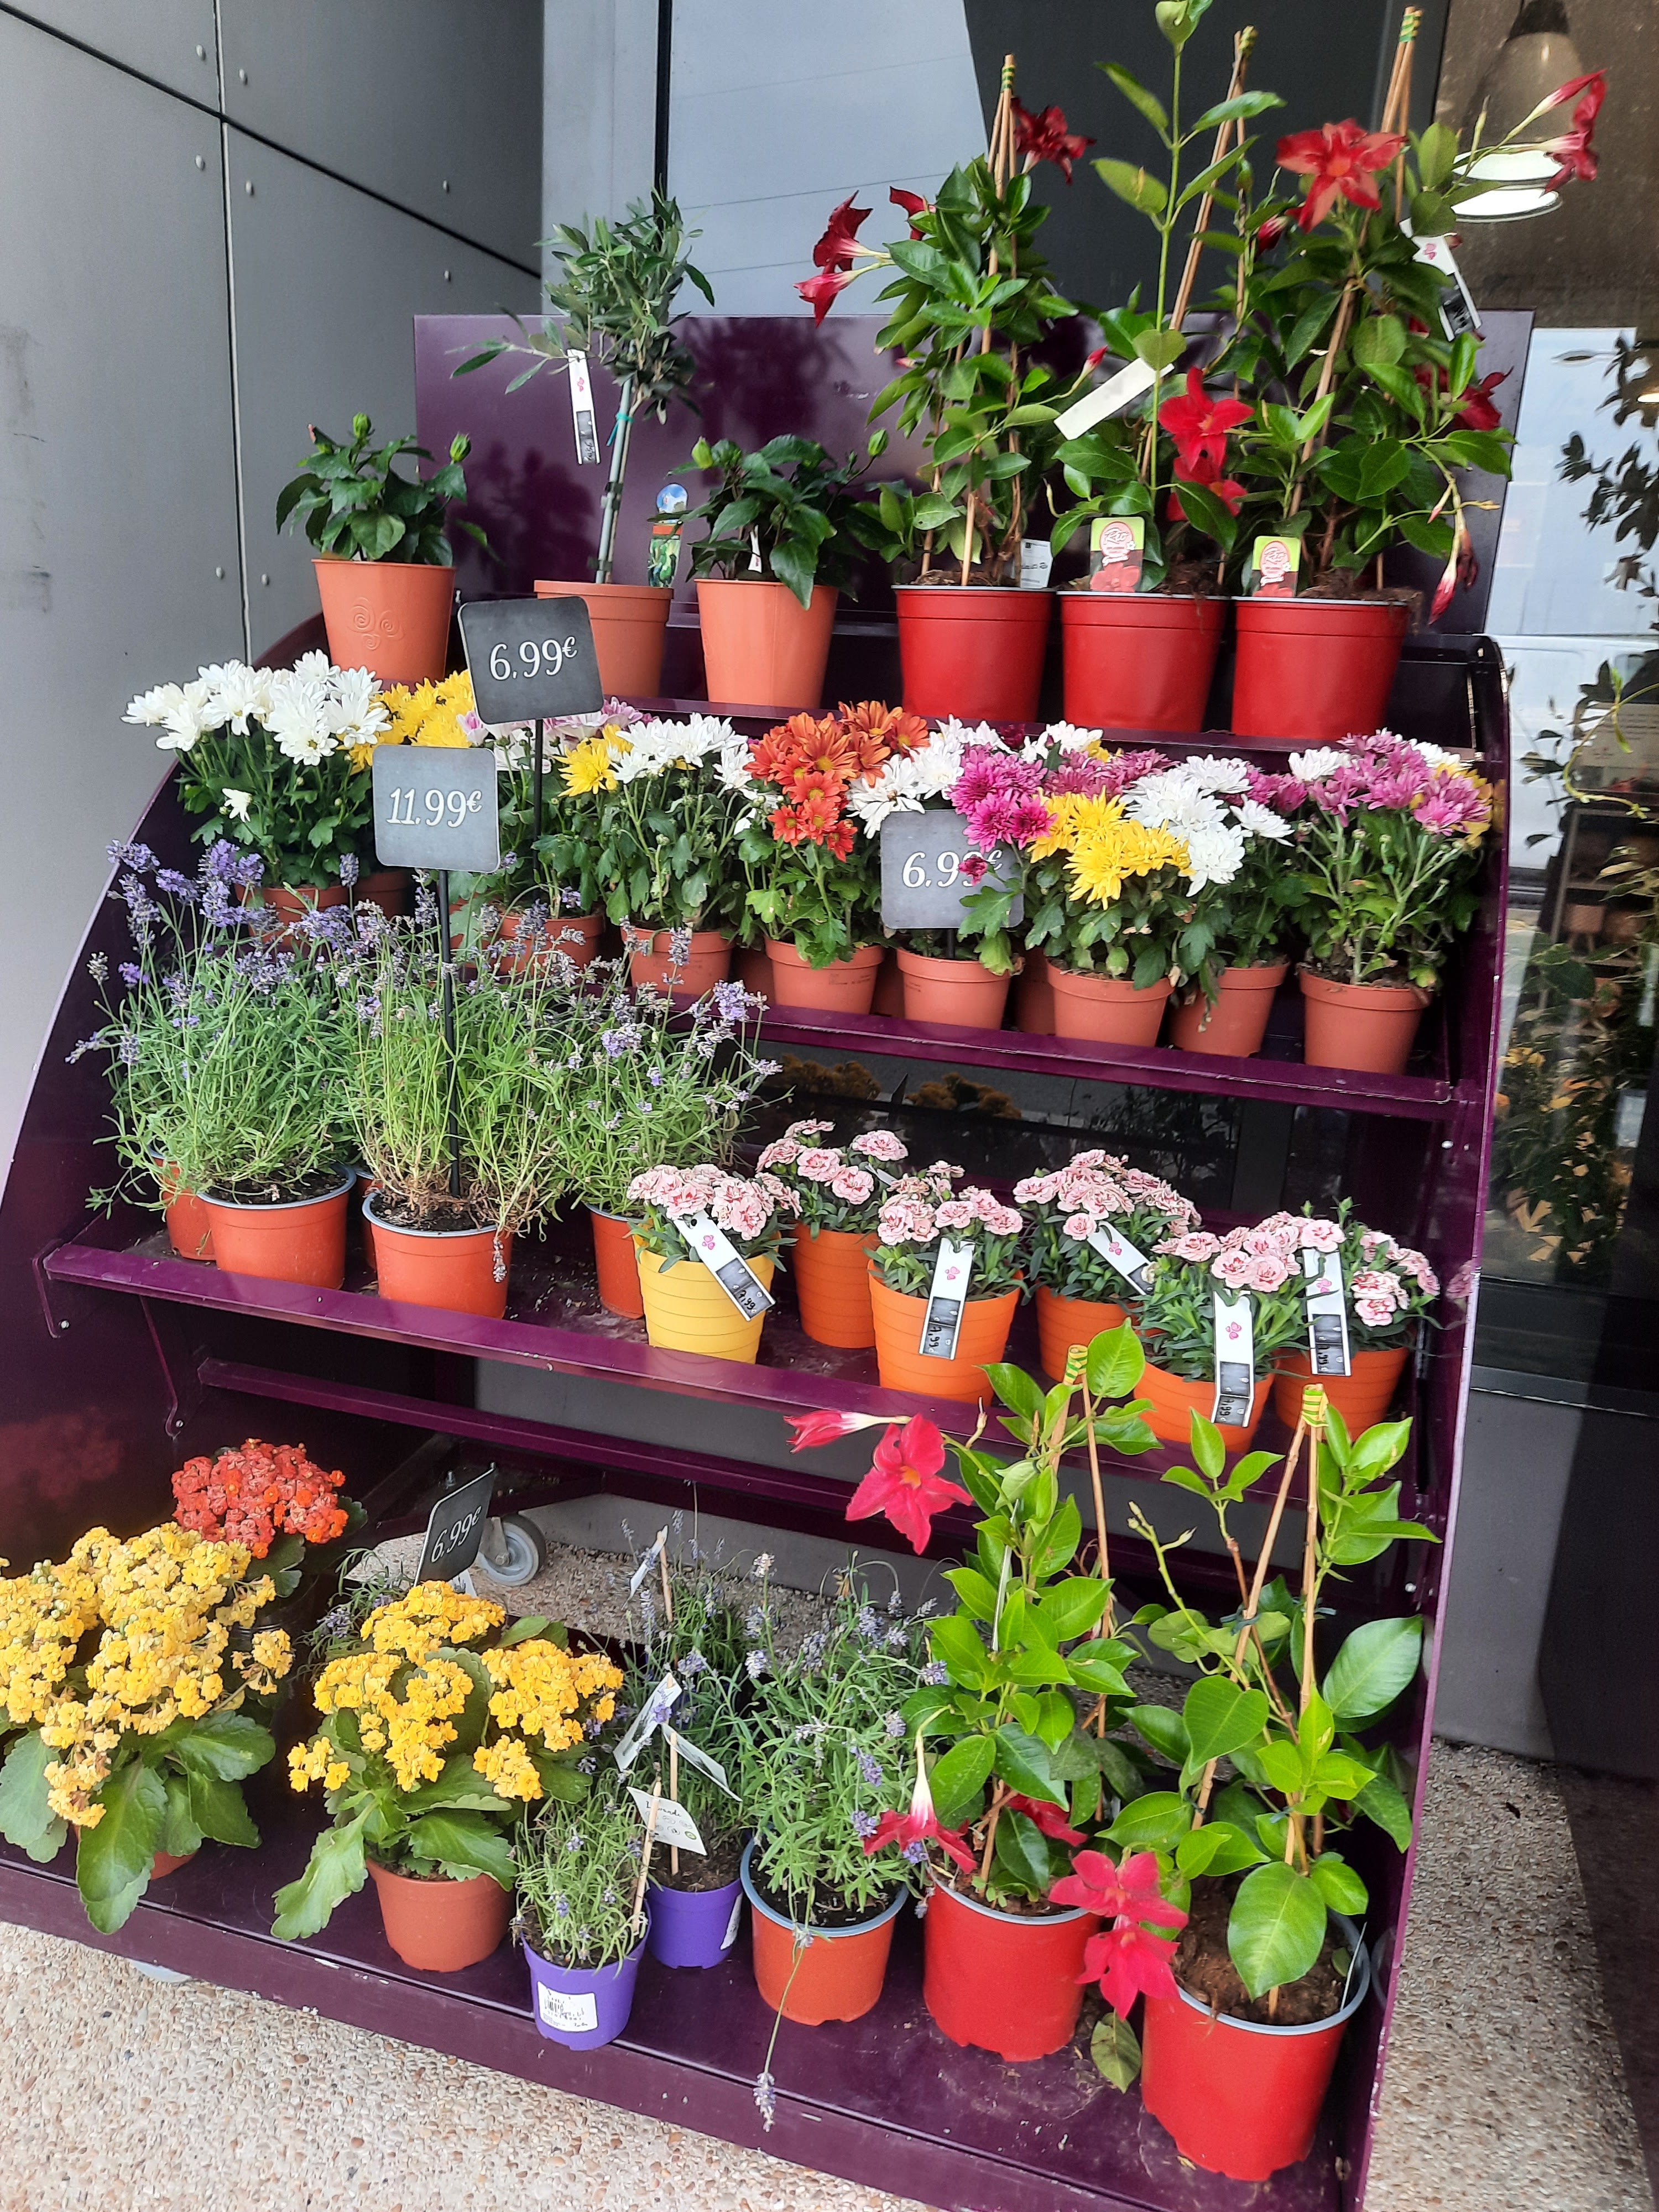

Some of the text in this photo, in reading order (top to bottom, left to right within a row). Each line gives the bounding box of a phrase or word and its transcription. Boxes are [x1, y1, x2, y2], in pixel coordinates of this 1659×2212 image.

[489, 636, 578, 681] 6.99€
[386, 787, 483, 827] 11.99€
[927, 1326, 942, 1348] 7,99
[431, 1506, 483, 1564] 6.99€
